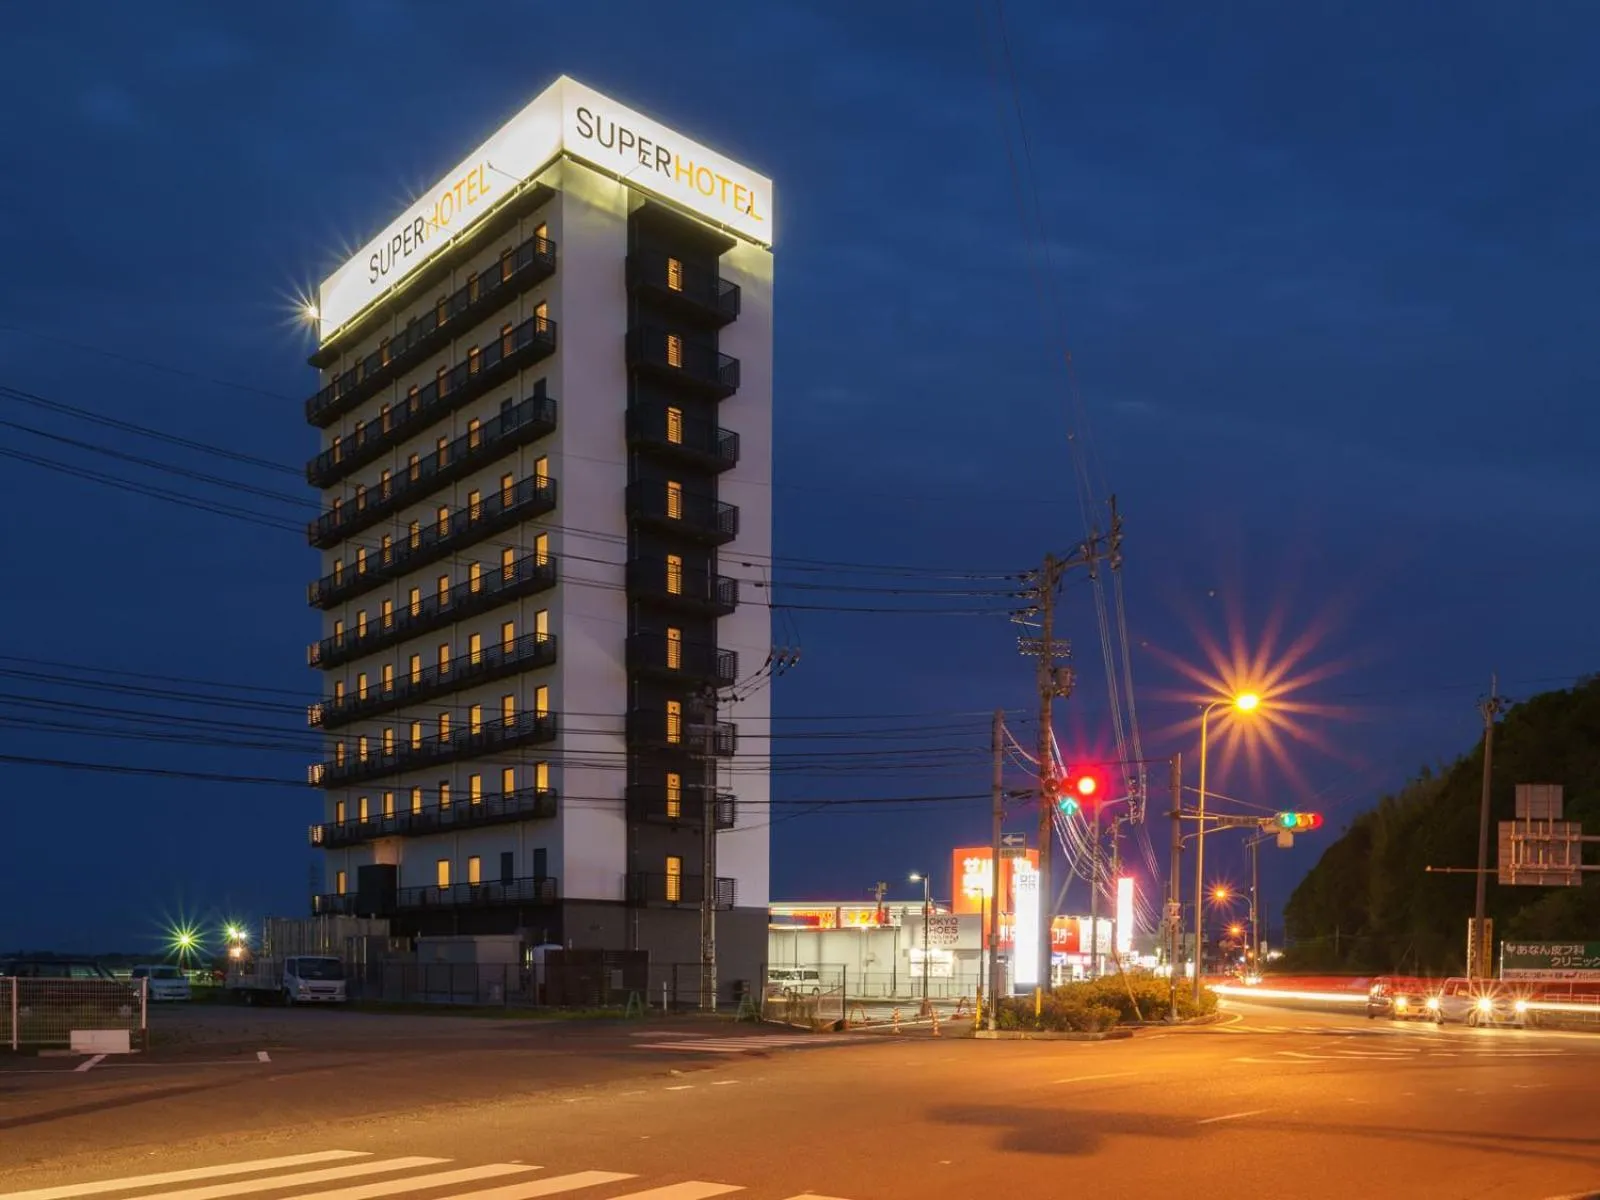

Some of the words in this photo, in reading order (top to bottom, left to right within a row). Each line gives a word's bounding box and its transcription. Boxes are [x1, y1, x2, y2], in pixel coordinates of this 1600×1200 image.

[1516, 944, 1585, 956] あなん皮フ科
[1550, 956, 1600, 967] クリニック
